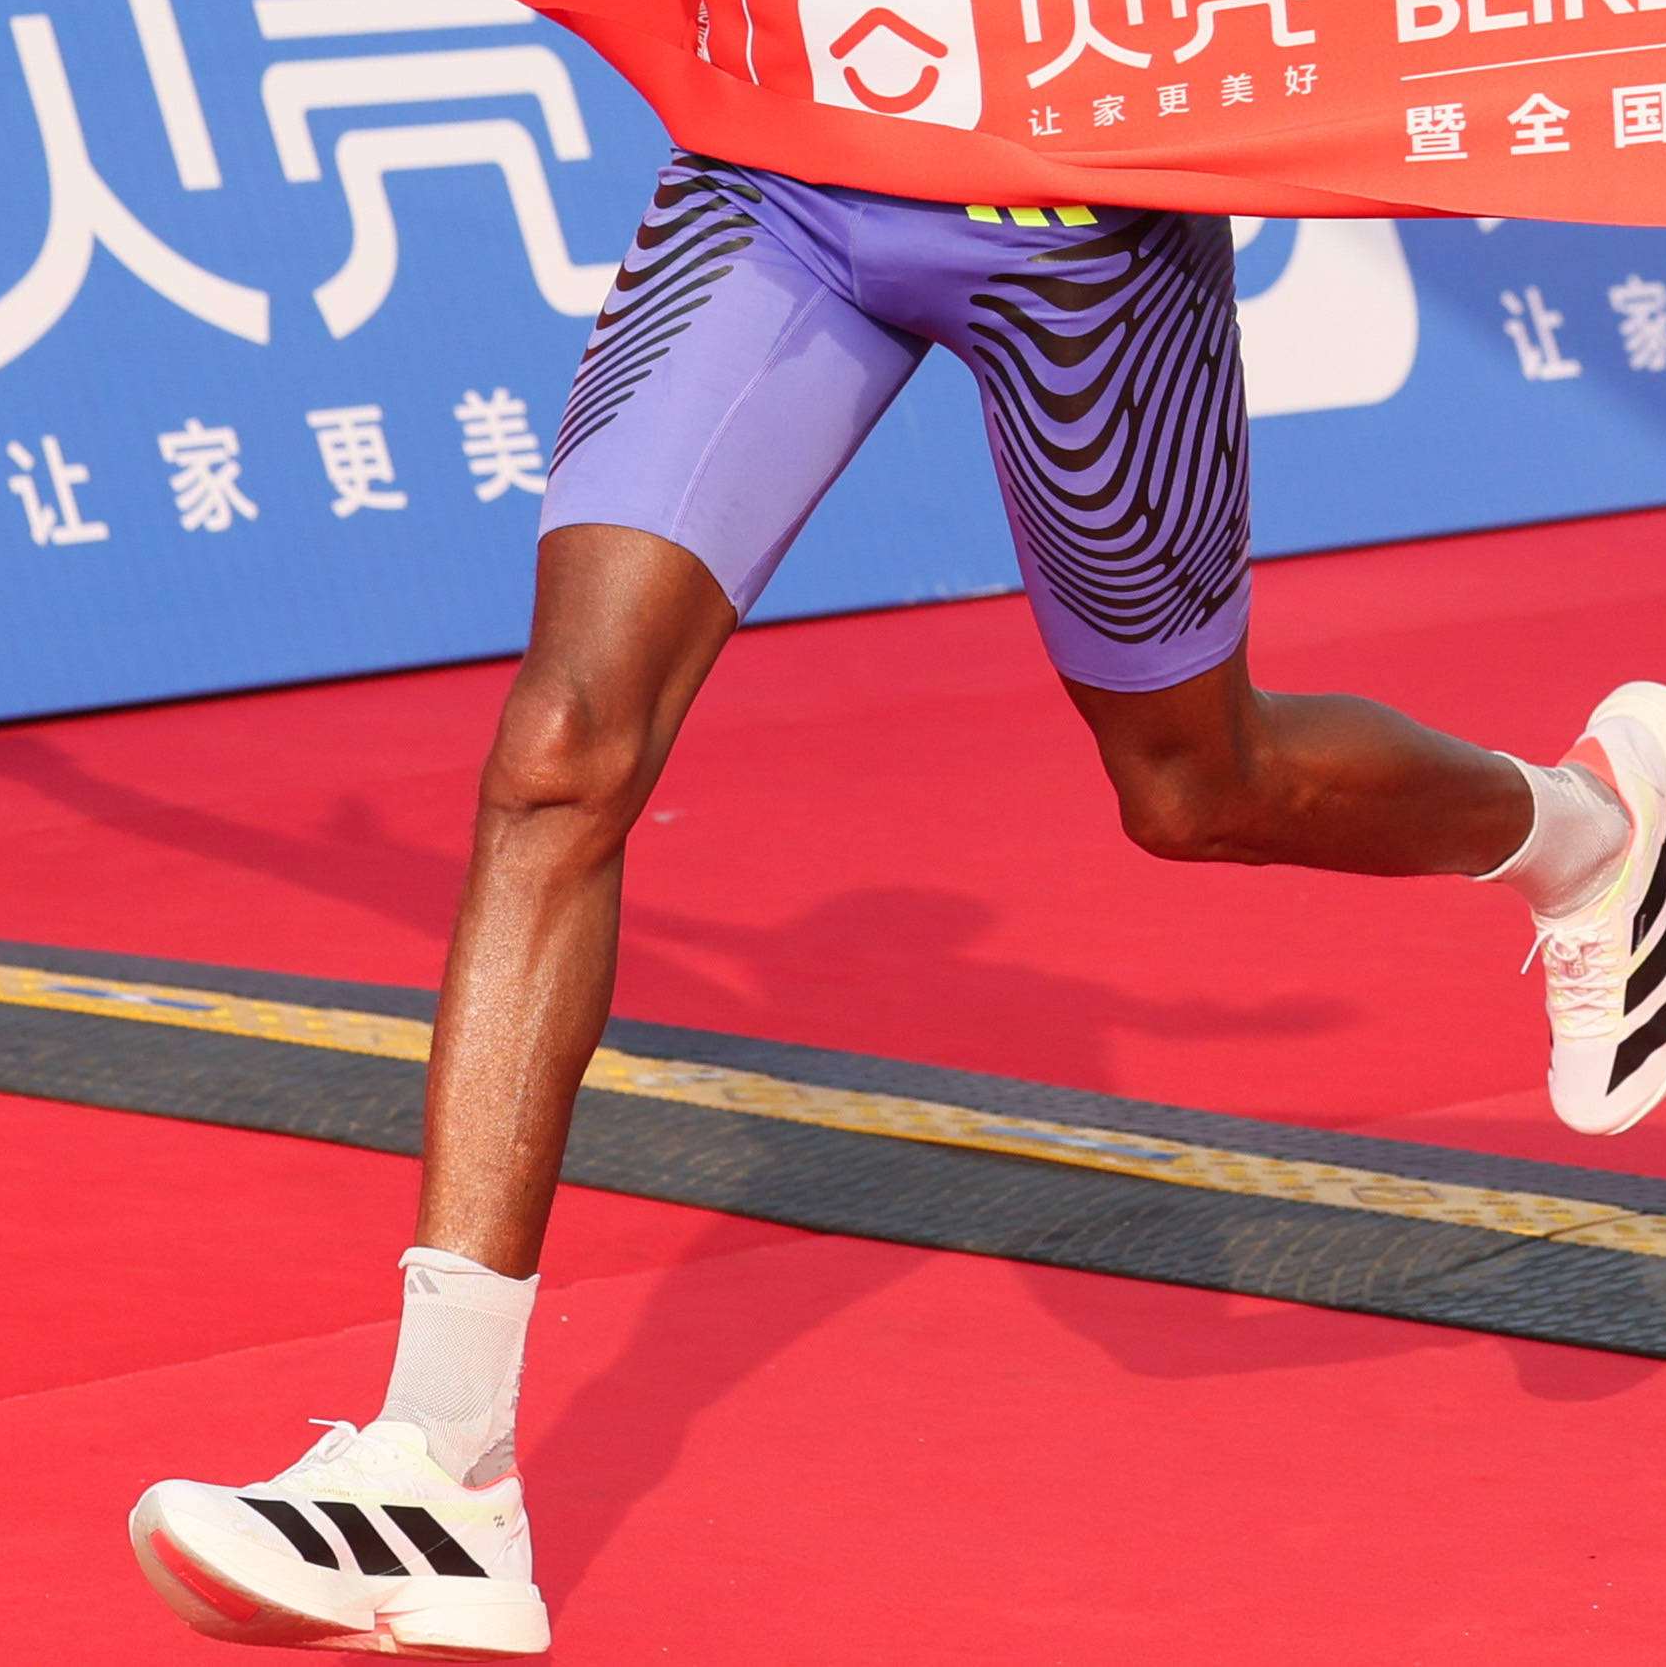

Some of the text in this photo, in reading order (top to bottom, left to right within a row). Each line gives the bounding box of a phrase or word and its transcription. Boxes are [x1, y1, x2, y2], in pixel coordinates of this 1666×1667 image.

[1028, 63, 1319, 137] 让家更美好
